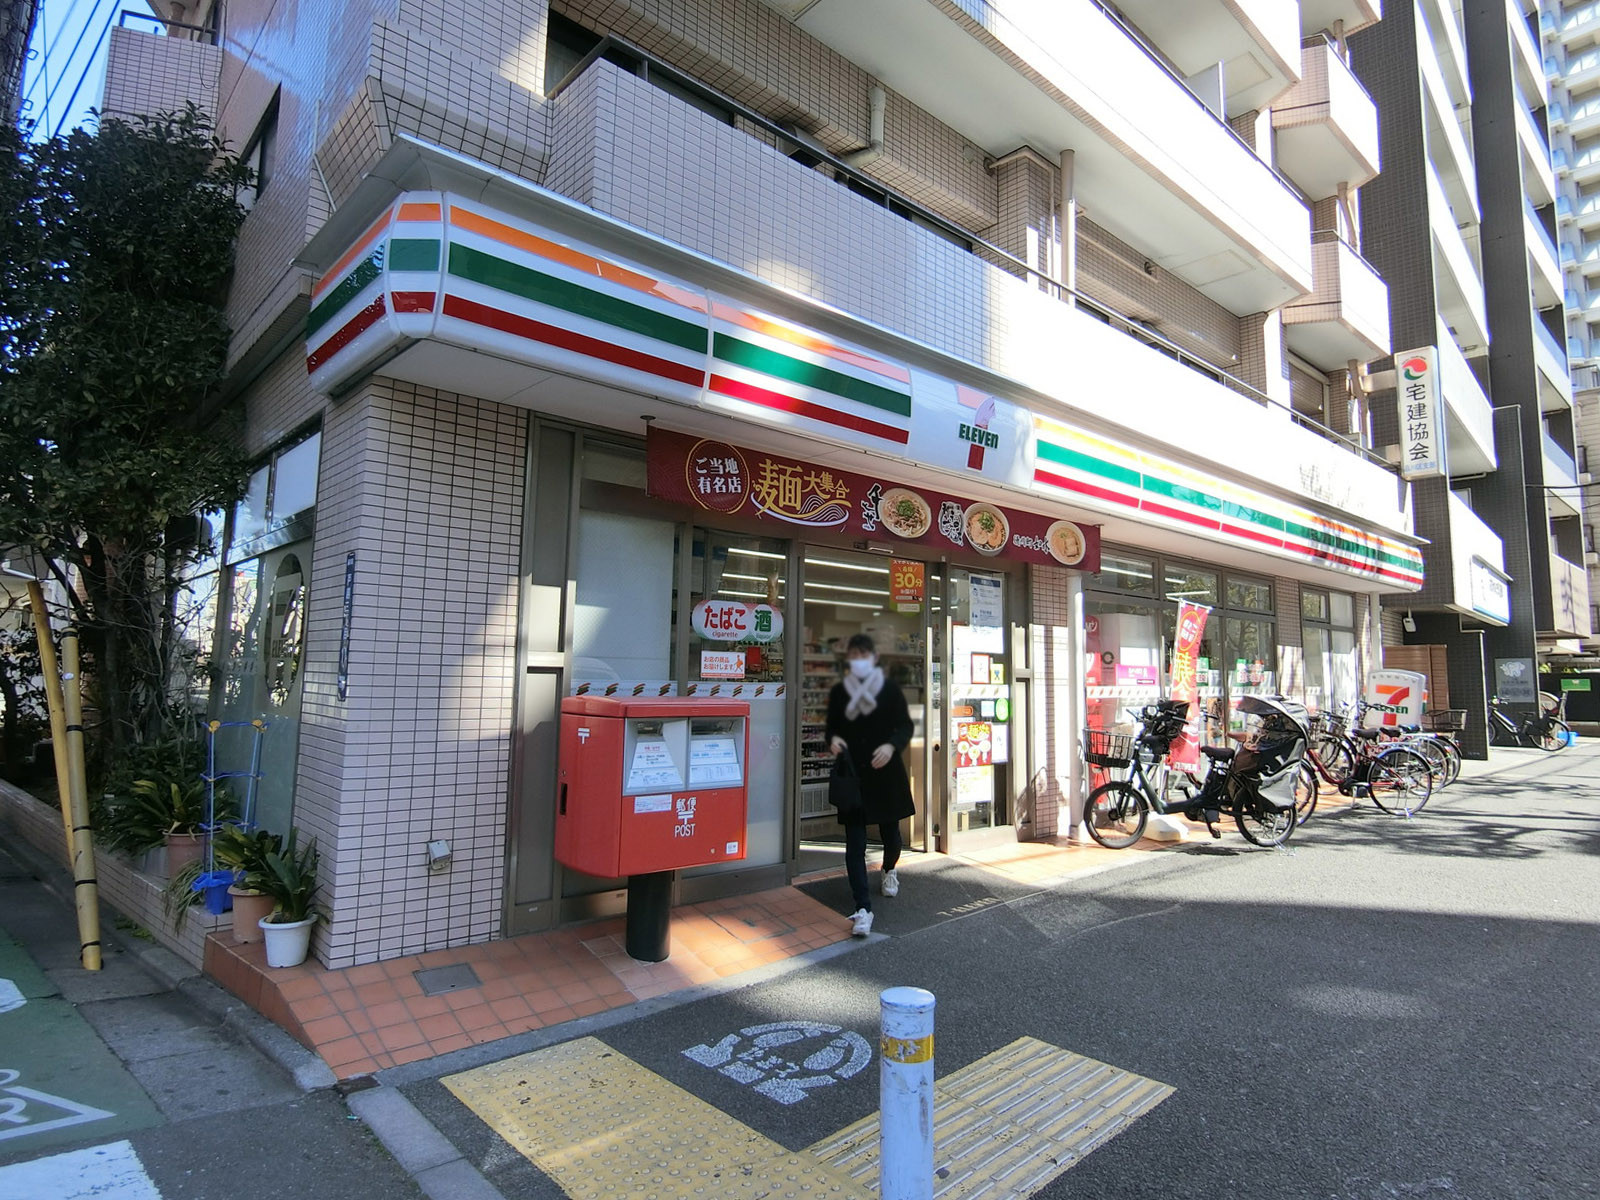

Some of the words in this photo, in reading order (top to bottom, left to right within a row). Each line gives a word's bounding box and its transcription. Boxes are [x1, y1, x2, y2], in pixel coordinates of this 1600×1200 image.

[1406, 383, 1430, 461] 宅建協会
[695, 457, 740, 475] ご当地
[697, 476, 742, 494] 有名店
[752, 459, 850, 516] 麺大集合
[894, 572, 923, 589] 30分
[704, 606, 746, 630] たばこ
[755, 610, 772, 632] 酒
[676, 796, 697, 813] 郵便
[674, 823, 696, 838] POST
